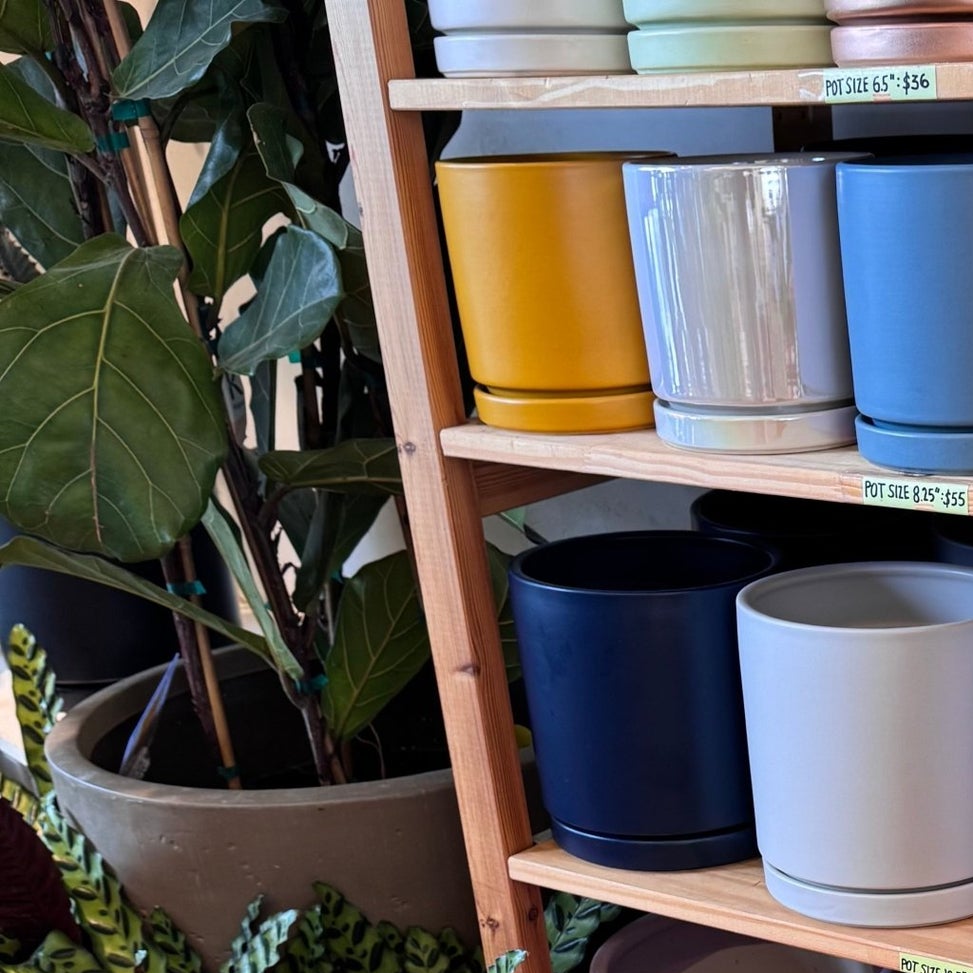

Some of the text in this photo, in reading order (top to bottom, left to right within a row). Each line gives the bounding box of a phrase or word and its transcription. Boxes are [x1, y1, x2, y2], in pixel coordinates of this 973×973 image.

[826, 78, 844, 96] POT
[846, 76, 869, 95] SIZE
[864, 480, 886, 499] POT
[887, 484, 910, 500] SIZE
[901, 958, 919, 973] POT
